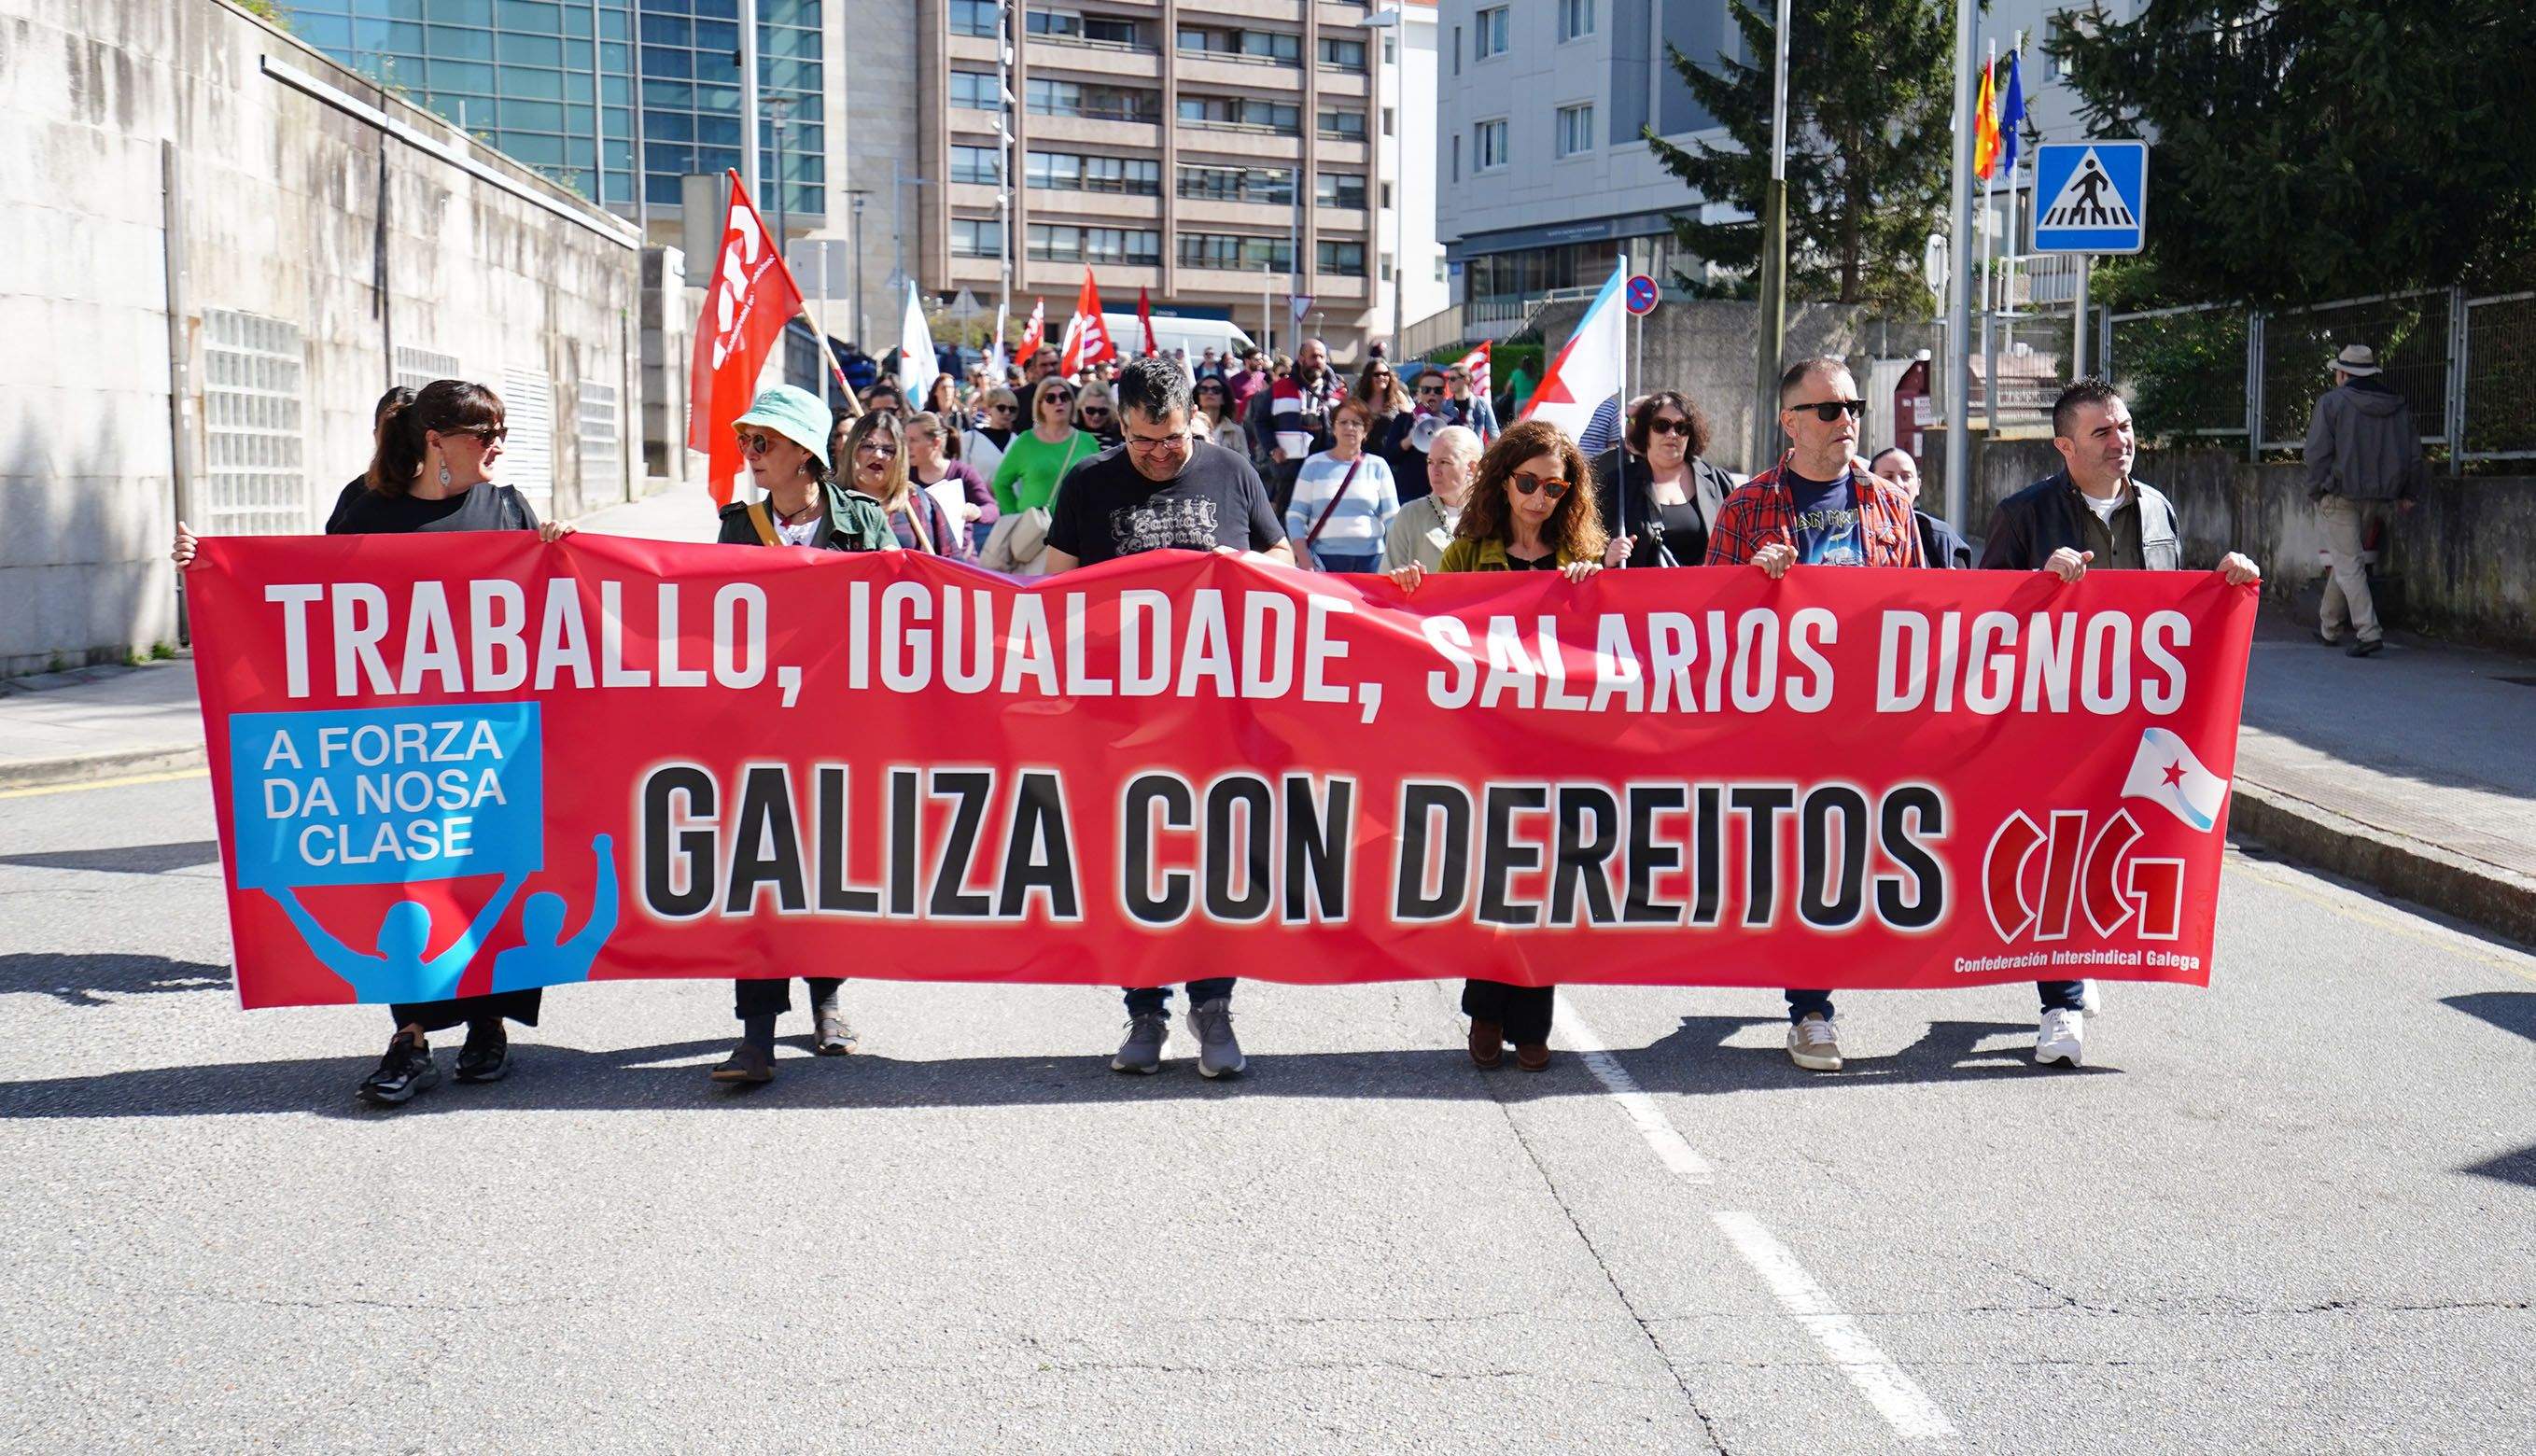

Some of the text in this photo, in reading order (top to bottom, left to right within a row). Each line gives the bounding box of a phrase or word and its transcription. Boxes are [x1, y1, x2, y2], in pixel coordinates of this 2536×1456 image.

[1133, 516, 1196, 535] Santa
[265, 578, 2192, 723] TRABALLO, IGUALDADE, SALARIOS DIGNOS
[262, 720, 504, 771] A FORZA
[262, 767, 507, 819] DA NOSA
[298, 817, 474, 867] CLASE
[640, 762, 1948, 931] GALIZA CON DEREITOS
[1983, 806, 2186, 945] CIG
[1955, 950, 2200, 973] Confederación Intersindical Galega
